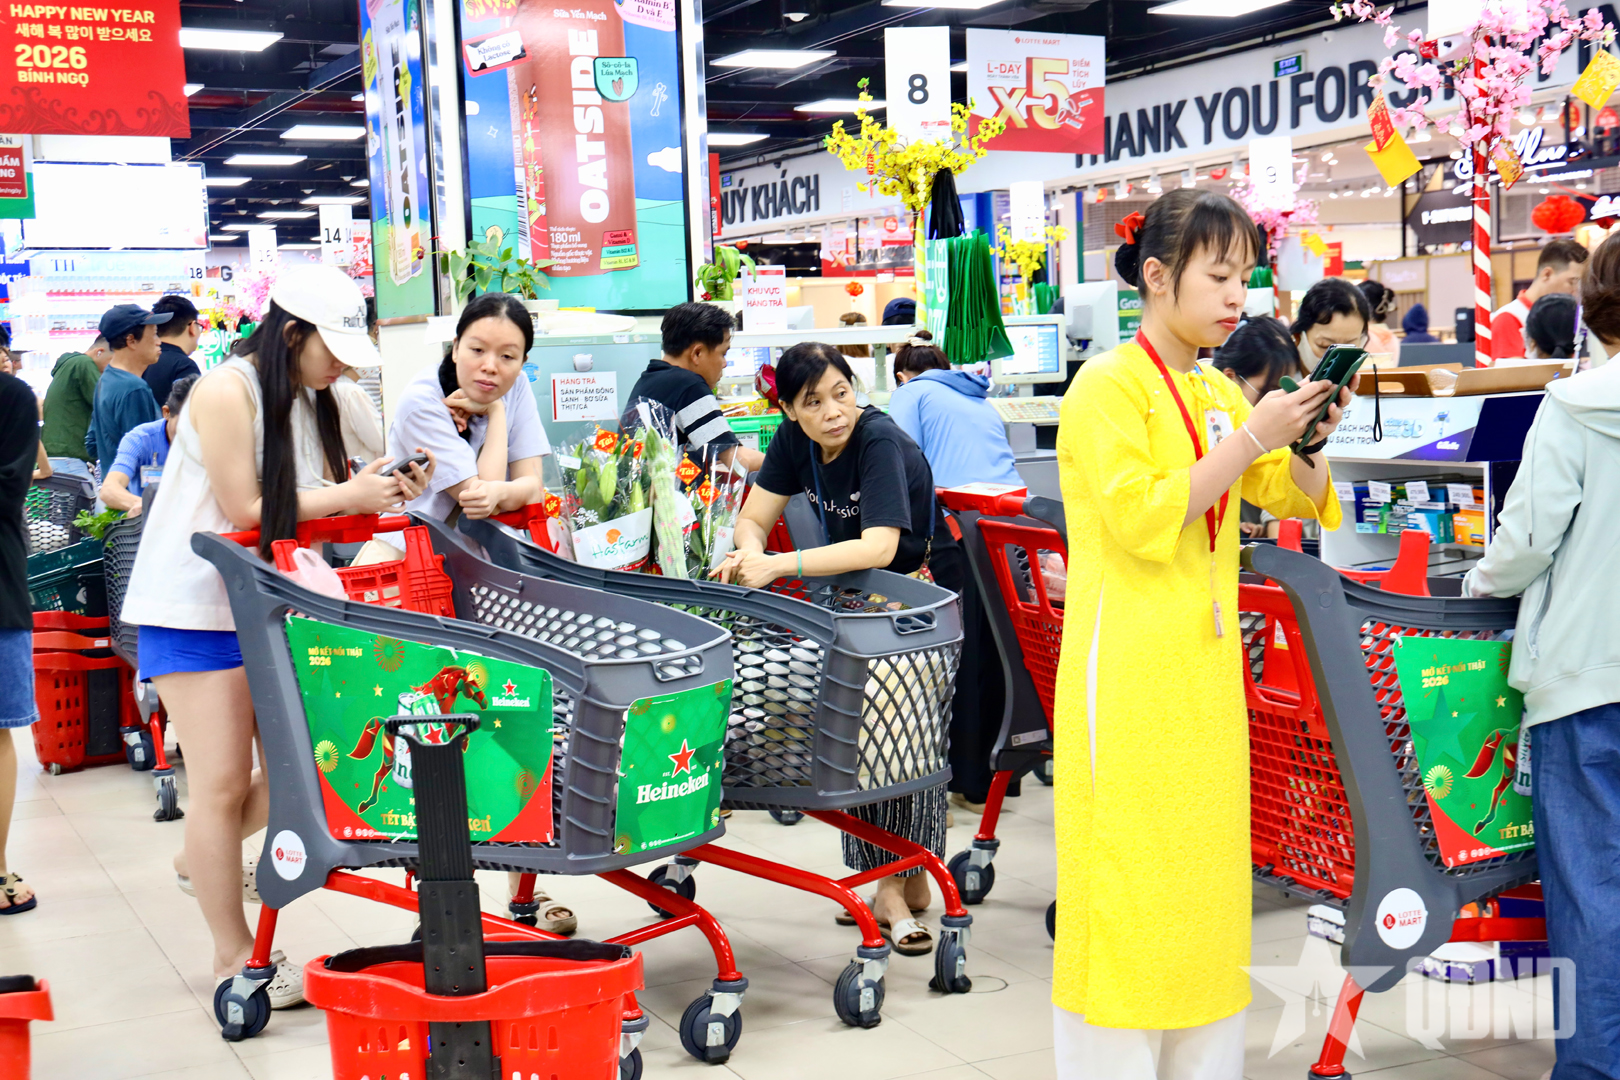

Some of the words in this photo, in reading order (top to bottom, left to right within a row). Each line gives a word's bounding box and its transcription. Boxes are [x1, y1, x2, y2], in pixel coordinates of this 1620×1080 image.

[10, 4, 67, 19] HAPPY
[70, 7, 108, 21] NEW
[110, 9, 155, 23] YEAR
[553, 9, 569, 18] Sữa
[570, 8, 585, 19] Yến
[586, 11, 607, 21] Mạch
[15, 23, 45, 38] 새해
[47, 25, 62, 39] 복
[65, 25, 94, 41] 많이
[96, 26, 153, 42] 받으세요
[477, 44, 501, 55] Không
[483, 50, 511, 61] Lactose
[15, 44, 87, 69] 2026
[615, 69, 633, 77] Mạch
[987, 62, 1022, 74] L-DAY
[1072, 69, 1089, 78] TÍCH
[17, 68, 54, 83] BÍNH
[57, 72, 89, 87] NGỌ
[907, 73, 929, 105] 8
[1194, 80, 1279, 145] YOU
[1290, 60, 1378, 130] FOR
[568, 29, 610, 223] OATSIDE
[1265, 165, 1277, 183] 9
[720, 178, 748, 227] UÝ
[751, 169, 820, 222] KHÁCH
[324, 227, 341, 244] 14
[550, 232, 568, 243] 180
[569, 232, 581, 242] ml
[189, 267, 203, 279] 18
[747, 287, 763, 295] KHU
[765, 287, 780, 296] VỰC
[746, 298, 767, 307] HÀNG
[560, 377, 581, 385] HÀNG
[598, 434, 614, 448] Tài
[680, 466, 695, 476] Tài
[545, 500, 558, 513] Lộc
[592, 535, 649, 559] Hasfarm
[308, 656, 331, 666] 2026
[1467, 659, 1486, 671] THẬT
[1421, 675, 1449, 688] 2026
[492, 696, 530, 707] Heineken
[636, 768, 711, 805] Heineken
[381, 809, 400, 826] TẾT
[1498, 822, 1519, 839] TẾT
[285, 856, 303, 864] MART
[1398, 909, 1422, 919] LOTTE
[1398, 916, 1422, 927] MART
